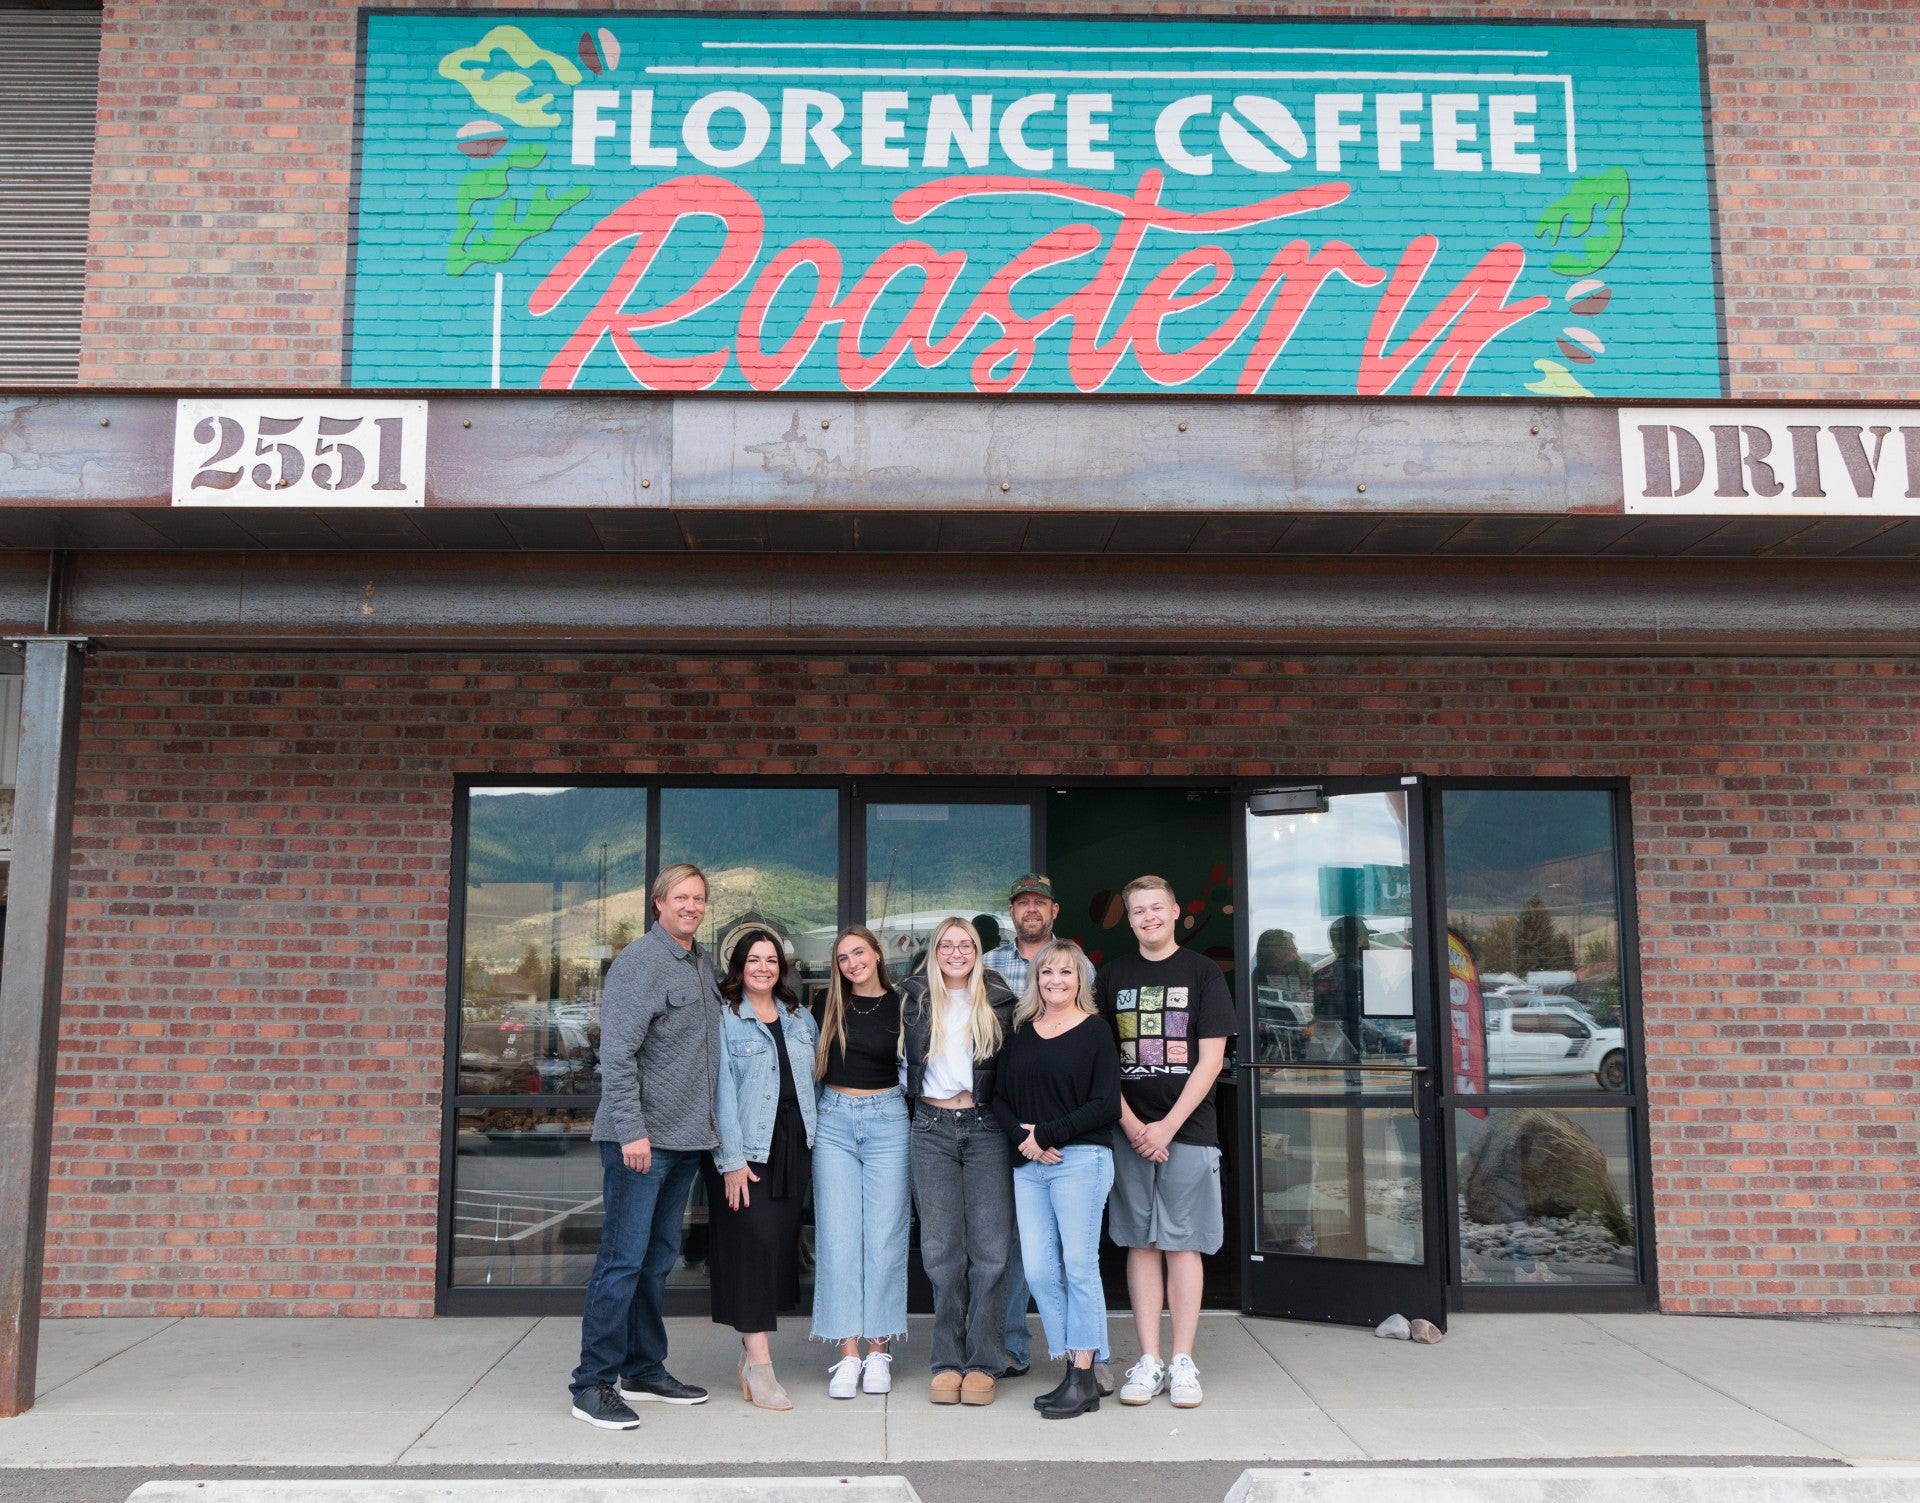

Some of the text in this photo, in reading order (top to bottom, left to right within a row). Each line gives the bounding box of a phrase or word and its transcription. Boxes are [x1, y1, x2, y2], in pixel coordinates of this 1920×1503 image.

[571, 88, 1542, 175] FLORENCE COFFEE
[528, 168, 1551, 396] Roastery
[190, 415, 408, 490] 2551
